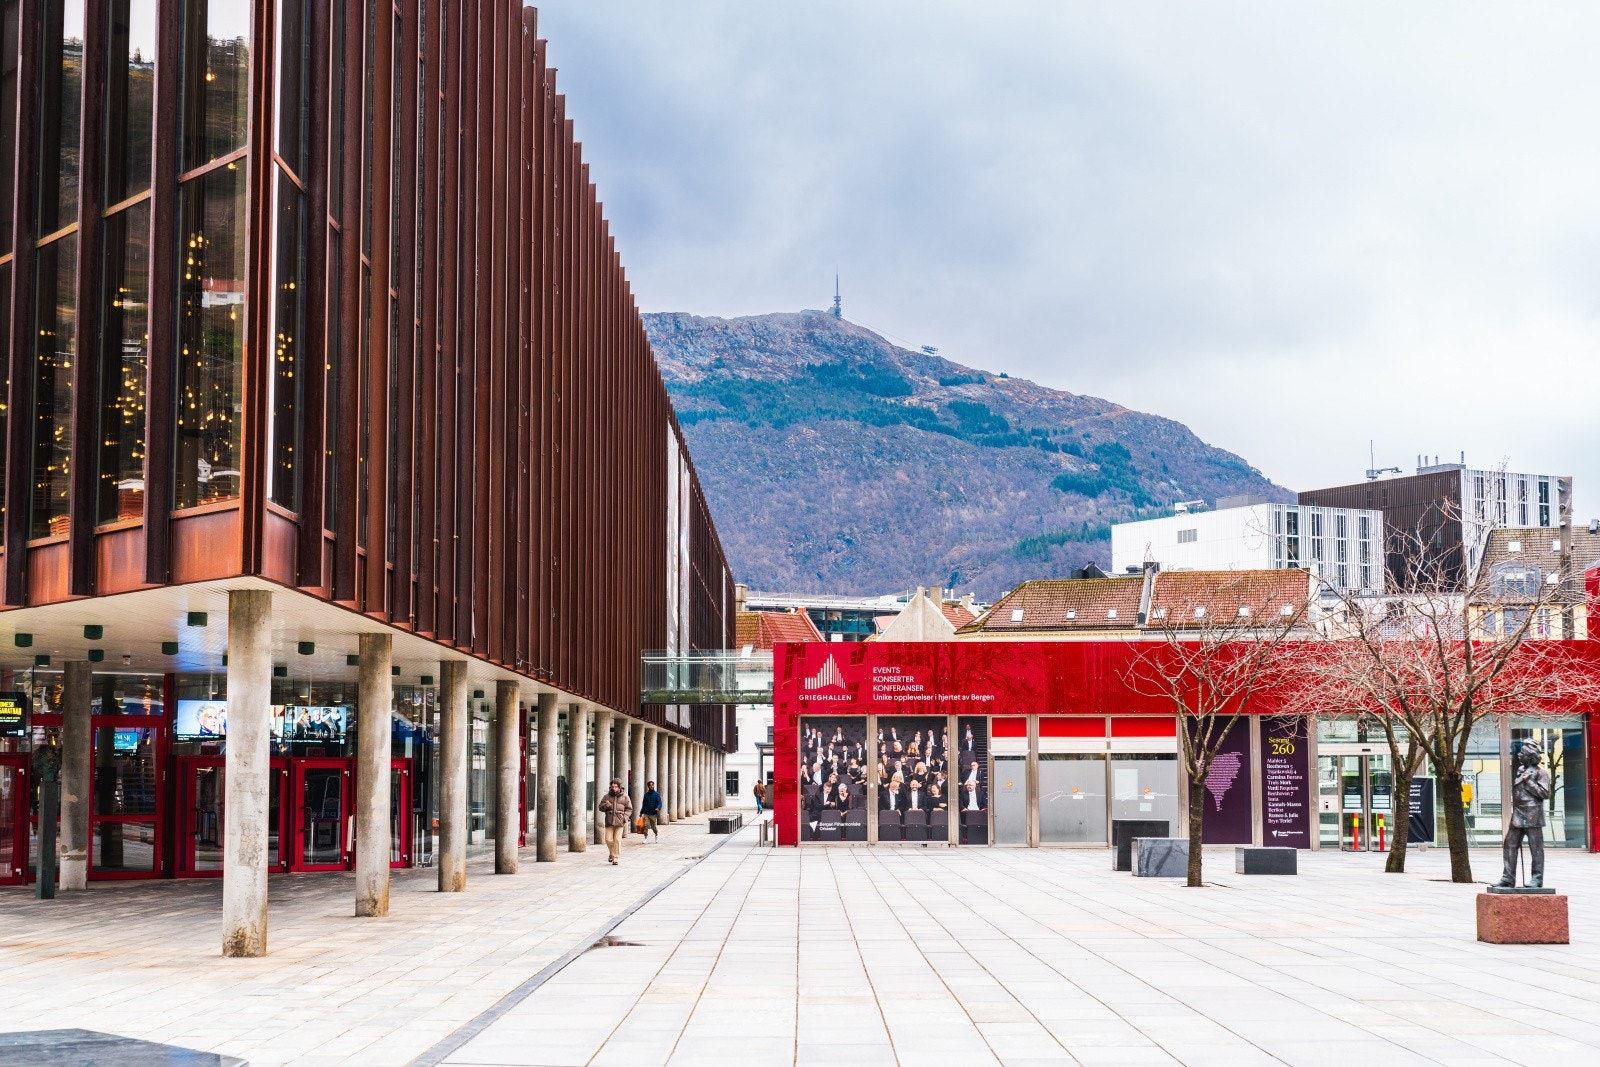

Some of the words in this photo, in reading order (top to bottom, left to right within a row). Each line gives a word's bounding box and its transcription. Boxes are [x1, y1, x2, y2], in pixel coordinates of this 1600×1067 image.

[893, 694, 933, 702] opplevelser
[938, 694, 960, 702] hjertet
[971, 694, 994, 702] Bergen
[1272, 744, 1295, 754] 260
